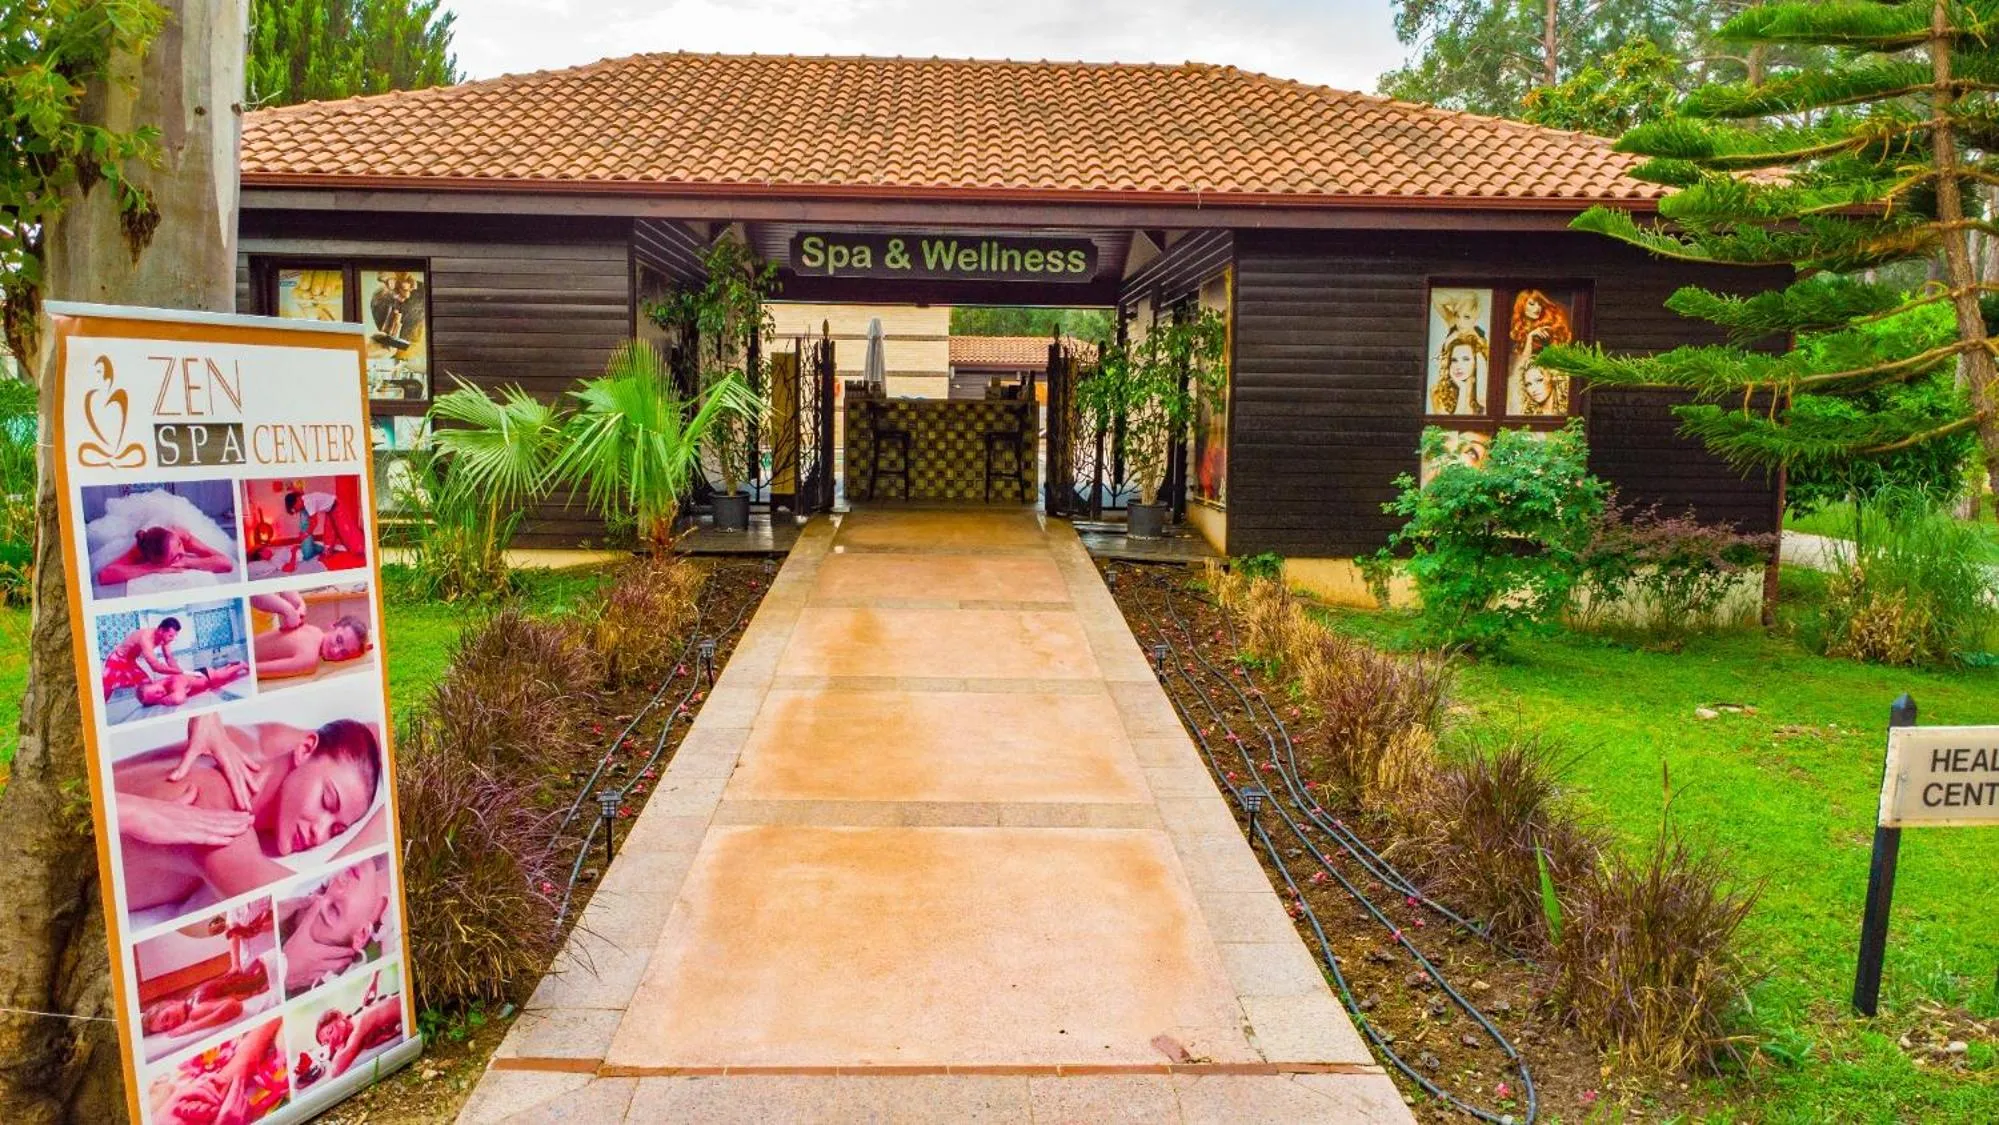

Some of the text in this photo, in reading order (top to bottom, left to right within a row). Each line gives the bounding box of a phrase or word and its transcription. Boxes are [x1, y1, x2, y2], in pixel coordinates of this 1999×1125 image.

[802, 237, 1086, 274] Spa & Wellness
[147, 356, 242, 416] ZEN
[158, 424, 358, 465] SPA CENTER
[1923, 782, 1999, 807] CENT
